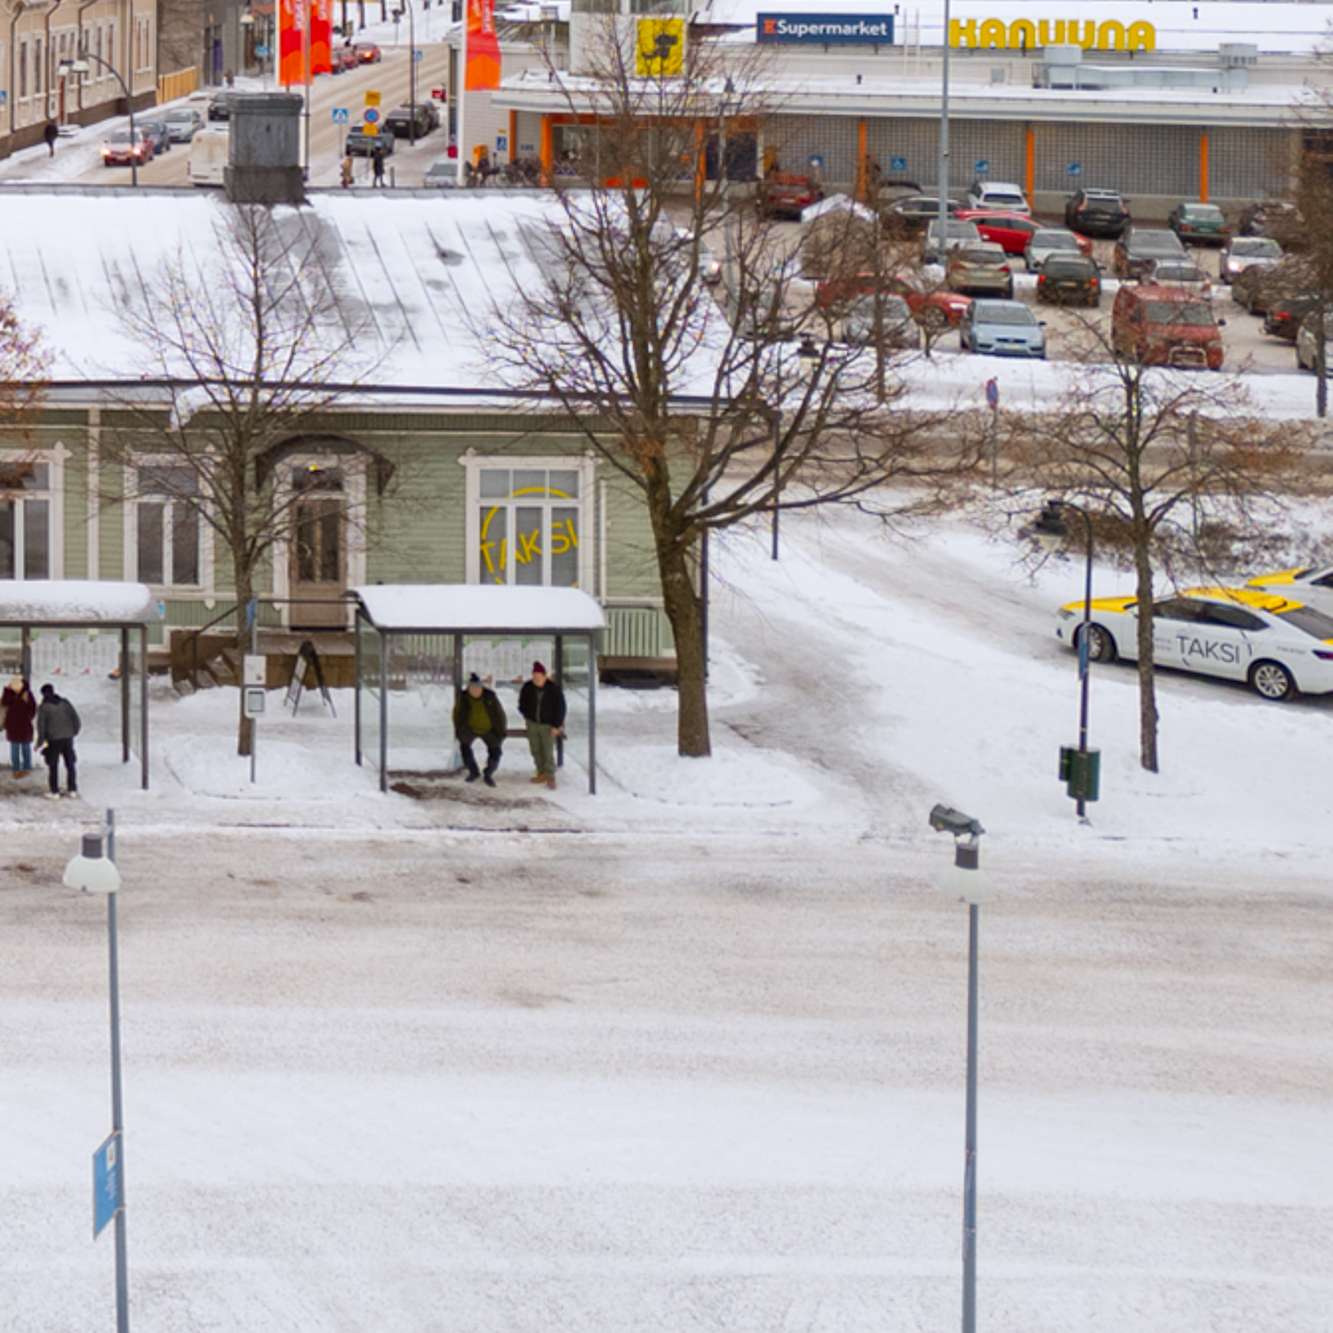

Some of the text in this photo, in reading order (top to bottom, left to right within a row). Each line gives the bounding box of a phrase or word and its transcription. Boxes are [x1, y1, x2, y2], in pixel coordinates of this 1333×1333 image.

[949, 18, 1155, 50] KANUUNA
[480, 519, 578, 573] TAKSI
[1176, 634, 1241, 664] TAKSI
